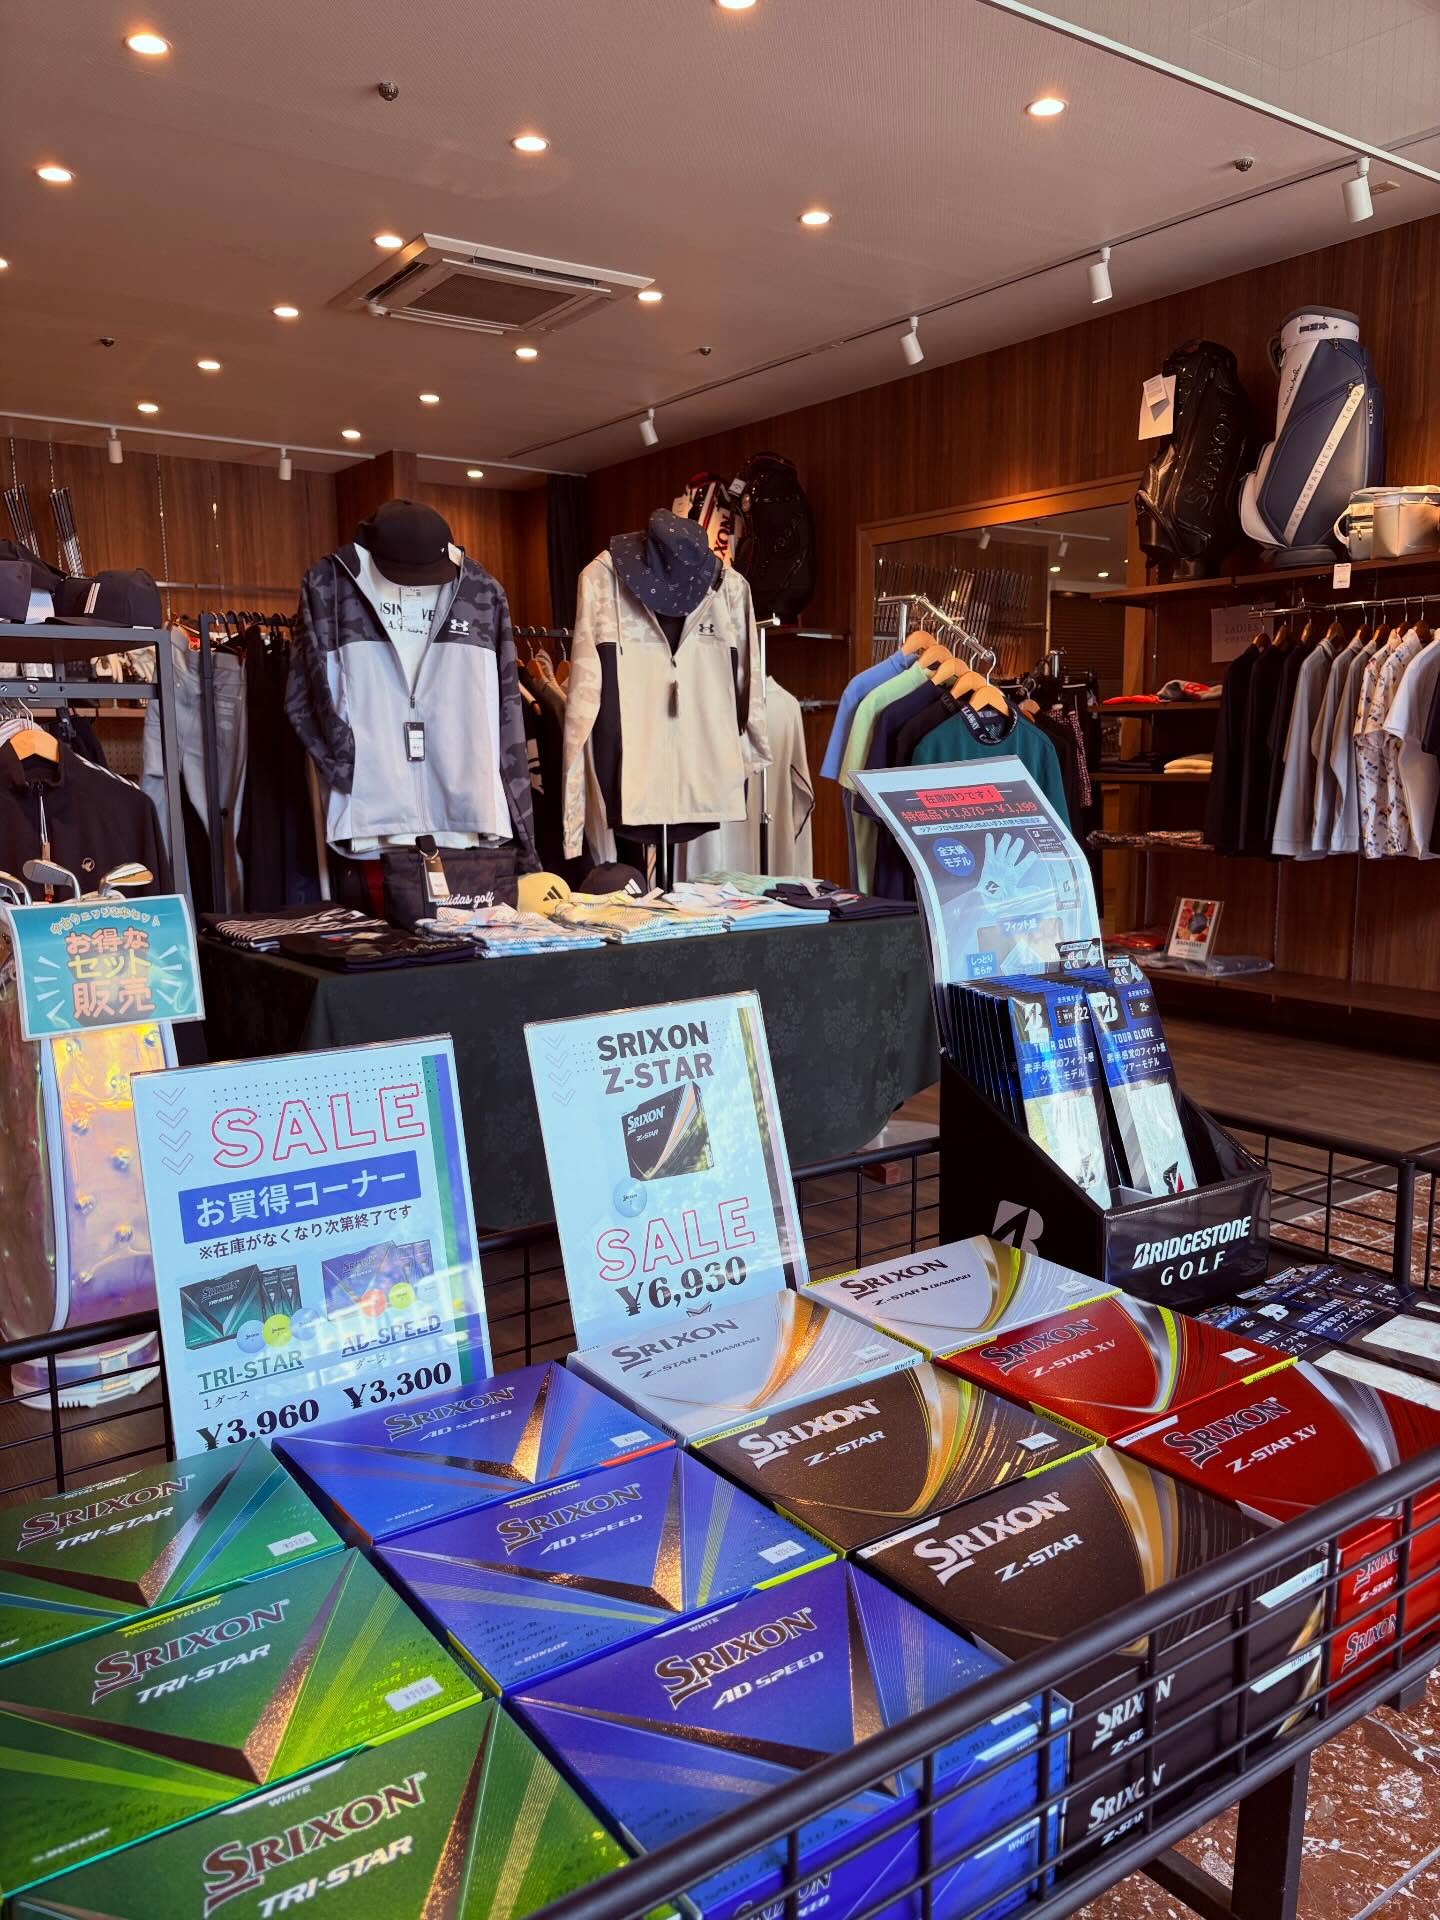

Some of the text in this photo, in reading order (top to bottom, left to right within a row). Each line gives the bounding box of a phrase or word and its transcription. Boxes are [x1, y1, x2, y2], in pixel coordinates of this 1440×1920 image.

[961, 706, 980, 730] LLAWAY
[937, 844, 968, 857] 全天候
[944, 856, 972, 868] モデル
[65, 927, 151, 954] お得な
[971, 954, 993, 965] しっとり
[68, 951, 151, 979] セット
[73, 979, 156, 1019] 販売
[597, 1021, 710, 1062] SRIXON
[1058, 1036, 1084, 1050] GLOVE
[1113, 1027, 1154, 1044] TOUR GLOVE
[602, 1052, 714, 1095] Z-STAR
[1122, 1056, 1160, 1073] ツアーモデル
[212, 1083, 426, 1168] SALE
[626, 1105, 666, 1136] SRIXON
[196, 1169, 406, 1229] お買得コーナー
[199, 1204, 412, 1260] ※在庫がなくなり次第終了です
[596, 1197, 756, 1281] SALE
[1131, 1215, 1251, 1270] BRIDGESTONE
[615, 1256, 748, 1317] ¥6,930
[840, 1259, 949, 1301] SRIXON
[1160, 1250, 1226, 1286] GOLF
[872, 1273, 972, 1306] Z-STAR DIAMOND
[342, 1314, 442, 1355] AD-SPEED
[611, 1318, 741, 1372] SRIXON
[979, 1318, 1098, 1376] SRIXON
[1253, 1329, 1281, 1344] LOVE
[198, 1350, 303, 1391] TRI-STAR
[639, 1336, 760, 1379] Z-STAR DIAMOND
[893, 1358, 916, 1371] WHITE
[1028, 1339, 1116, 1378] Z-STAR XV
[203, 1389, 250, 1411] 1ダース
[343, 1362, 452, 1410] ¥3,300
[196, 1399, 320, 1451] ¥3,960
[384, 1386, 515, 1442] SRIXON
[418, 1409, 512, 1441] AD SPEED
[660, 1423, 680, 1439] WHITE
[738, 1398, 882, 1471] SRIXON
[1042, 1411, 1071, 1430] PASSION
[1071, 1423, 1099, 1443] YELLOW
[1163, 1396, 1291, 1470] SRIXON
[803, 1430, 887, 1467] Z-STAR
[1225, 1424, 1318, 1474] Z-STAR XV
[17, 1474, 195, 1551] SRIXON
[55, 1506, 174, 1551] TRI-STAR
[497, 1482, 641, 1556] SRIXON
[539, 1514, 643, 1555] AD SPEED
[913, 1491, 1071, 1587] SRIXON
[994, 1533, 1084, 1583] Z-STAR
[123, 1599, 222, 1639] PASSION YELLOW
[688, 1616, 720, 1633] WHITE
[92, 1598, 290, 1704] SRIXON
[654, 1606, 818, 1710] SRIXON
[137, 1644, 271, 1703] TRI-STAR
[713, 1650, 824, 1710] AD SPEED
[1092, 1673, 1175, 1751] SRIXN
[268, 1785, 312, 1808] WHITE
[203, 1772, 427, 1919] SRIXON
[258, 1835, 413, 1919] TRI-STAR
